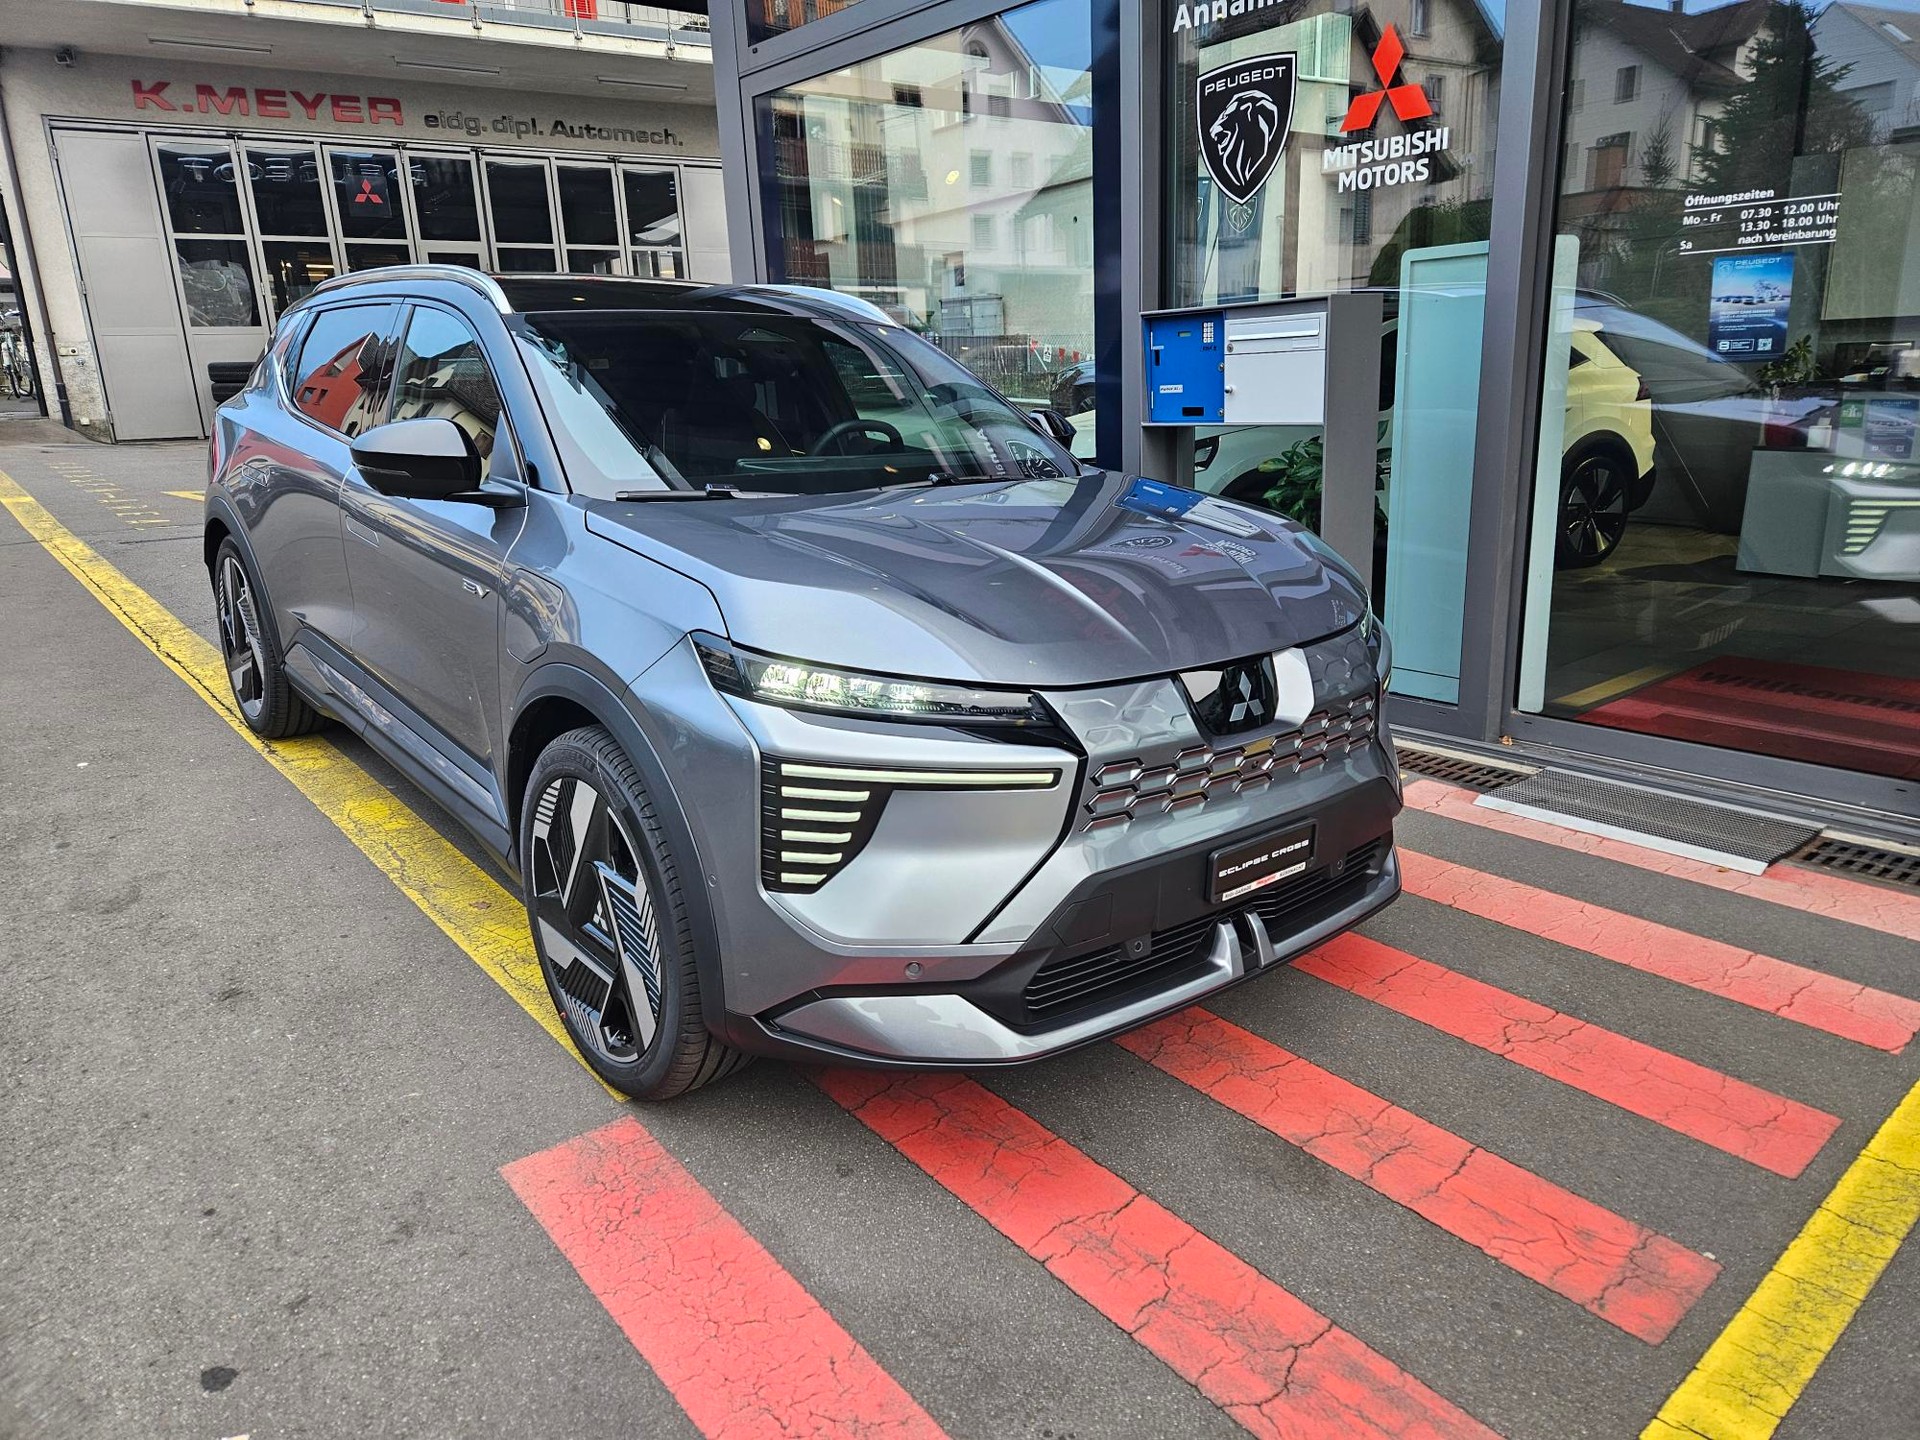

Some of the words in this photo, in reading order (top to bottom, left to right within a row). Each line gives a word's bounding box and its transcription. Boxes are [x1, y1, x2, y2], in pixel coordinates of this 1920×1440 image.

[1204, 65, 1287, 96] PEUGEOT
[131, 79, 404, 126] K.MEYER
[424, 111, 488, 137] eidg.
[492, 115, 544, 140] dipl.
[550, 120, 684, 147] Automech.
[1323, 127, 1449, 170] MITSUBISHI
[1338, 158, 1430, 193] MOTORS
[1683, 214, 1701, 226] Mo
[1710, 213, 1722, 223] Fr
[1741, 207, 1772, 220] 07.30
[1783, 203, 1815, 216] 12.00
[1818, 201, 1840, 212] Uhr
[1684, 188, 1775, 208] Öffnungszeiten
[1740, 221, 1770, 232] 13.30
[1782, 217, 1812, 228] 18.00
[1816, 214, 1838, 225] Uhr
[1680, 240, 1693, 250] Sa
[1738, 234, 1763, 245] nach
[1765, 228, 1837, 244] Vereinbarung
[1735, 257, 1782, 267] PEUGEOT
[1218, 854, 1269, 878] ECLIPSE
[1271, 839, 1310, 859] CROSS
